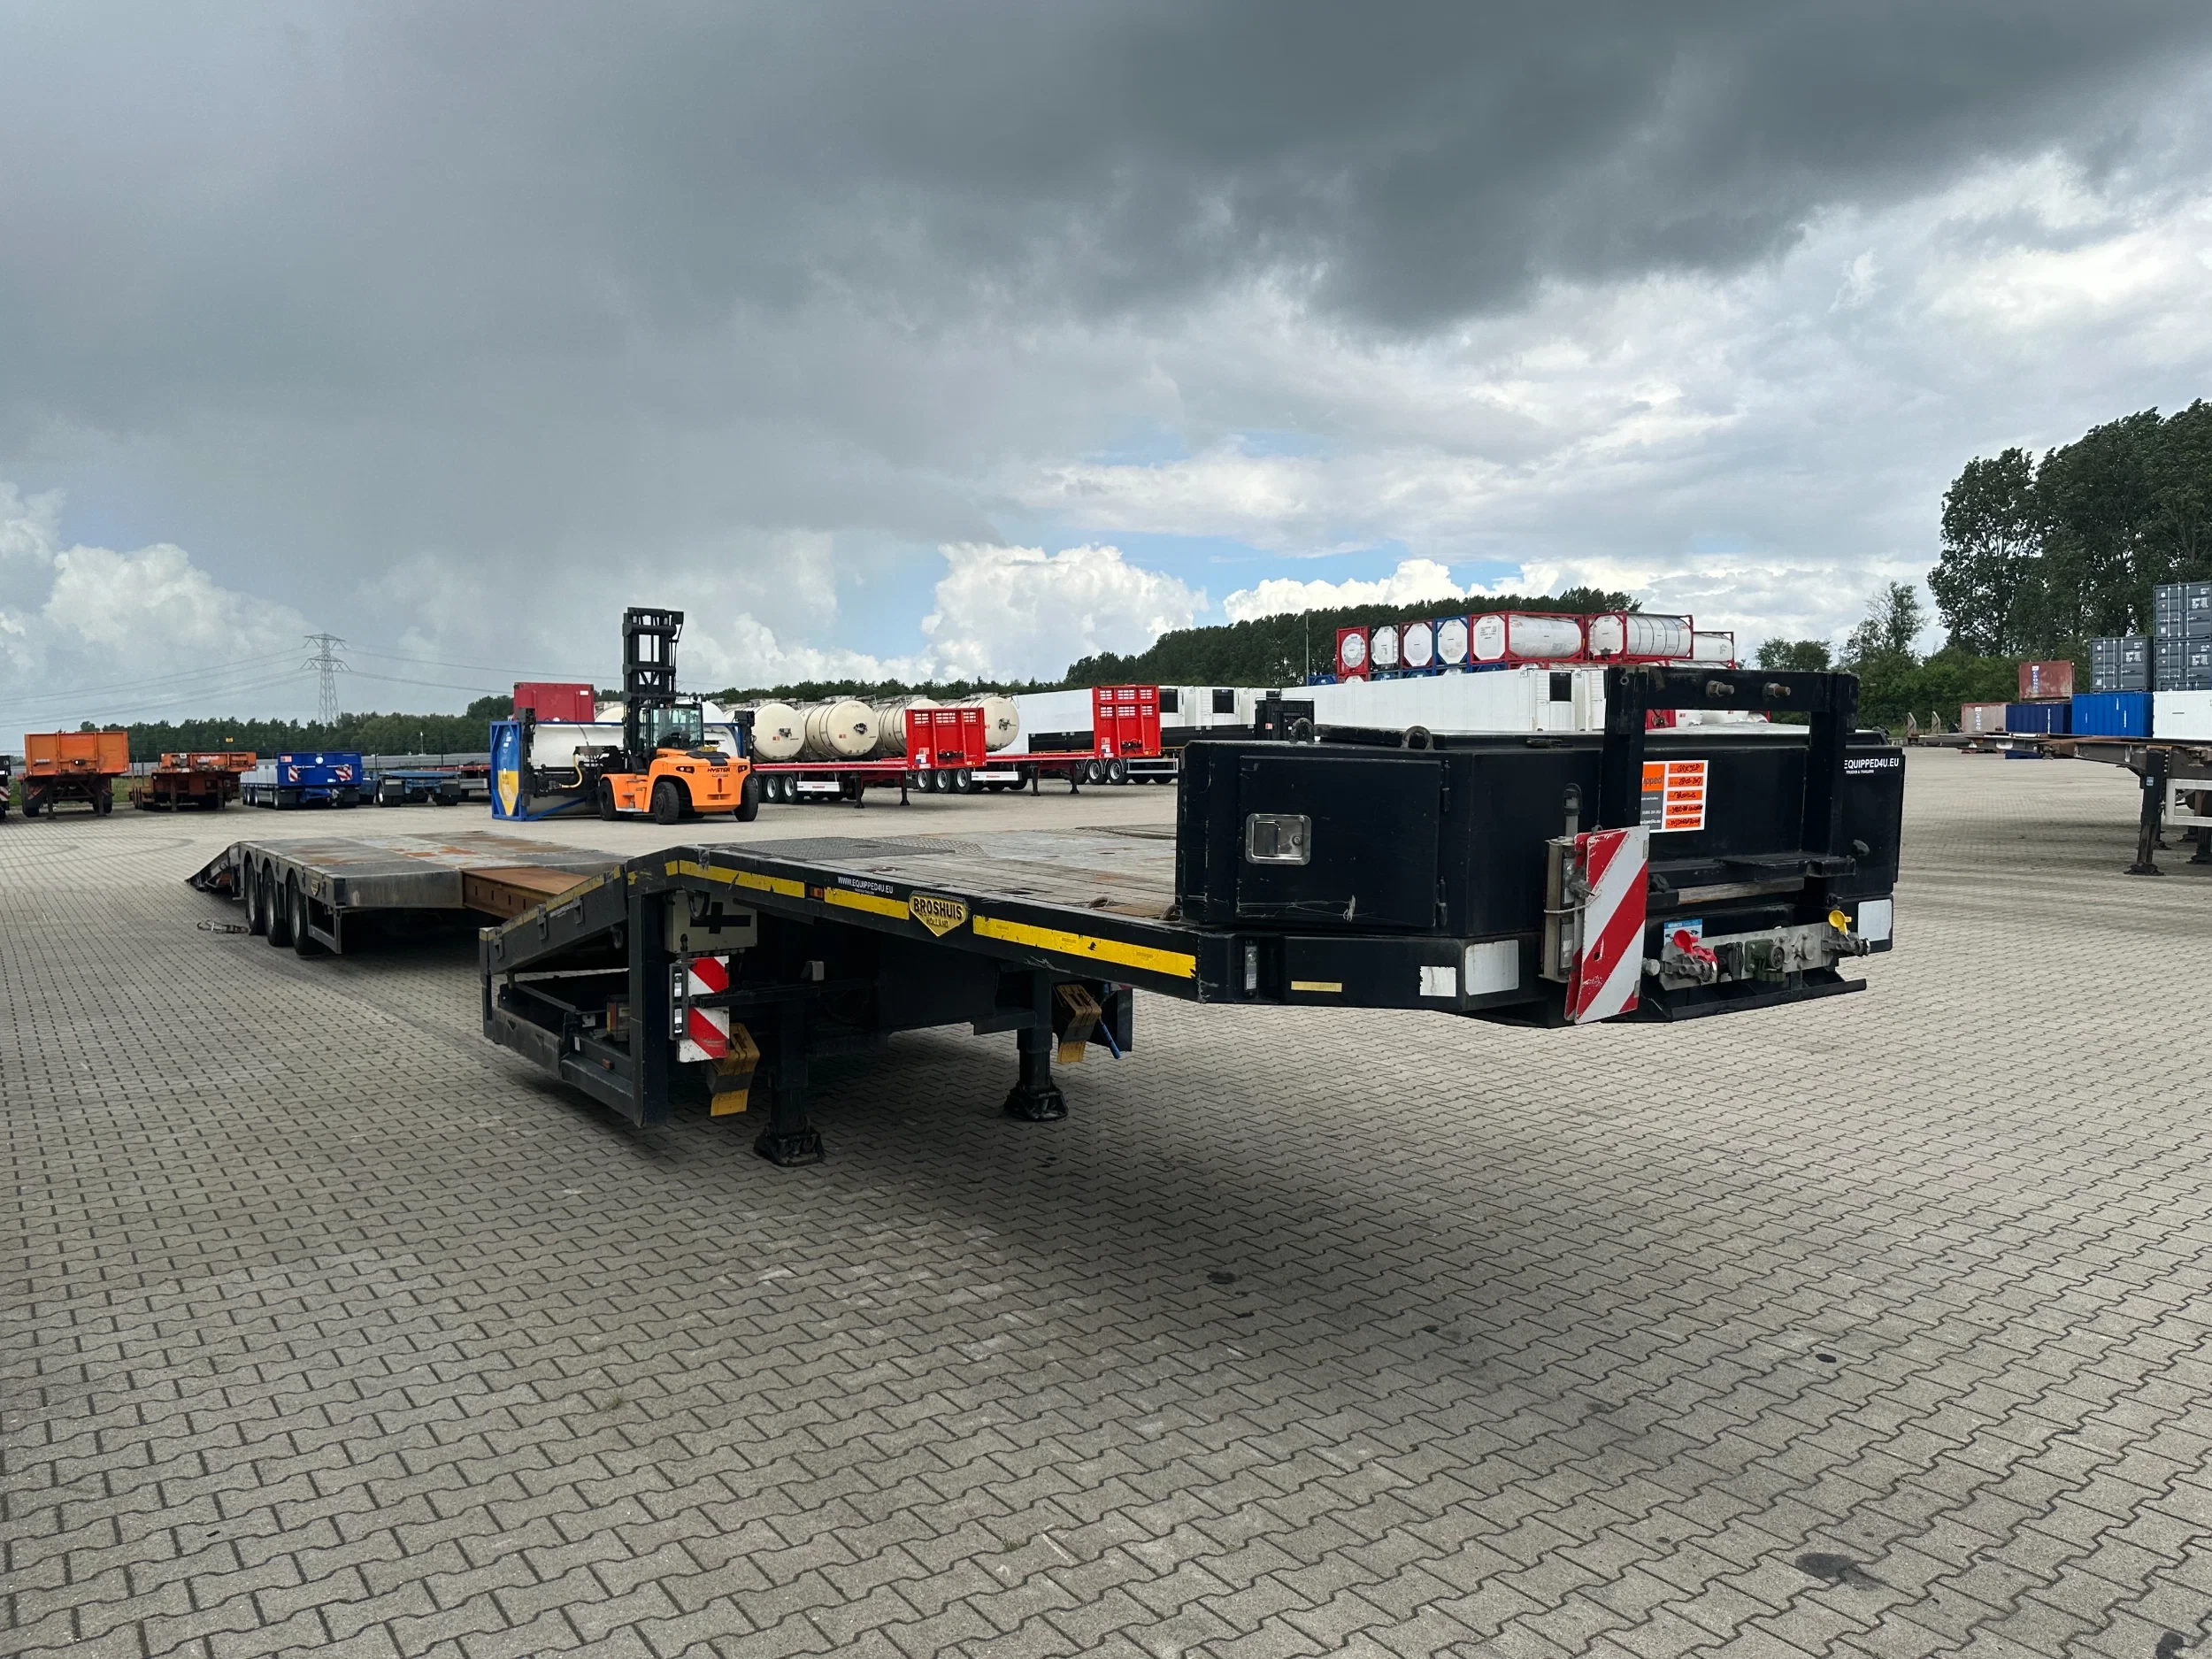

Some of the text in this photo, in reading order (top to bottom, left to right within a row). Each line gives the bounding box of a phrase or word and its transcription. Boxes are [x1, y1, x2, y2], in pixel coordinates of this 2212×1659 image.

[1844, 758, 1900, 769] EQUIPPED4U.EU
[837, 875, 894, 895] WWW.EQUIPPED4U.EU
[913, 897, 964, 920] BROSHUIS
[926, 916, 949, 929] HOLLAND
